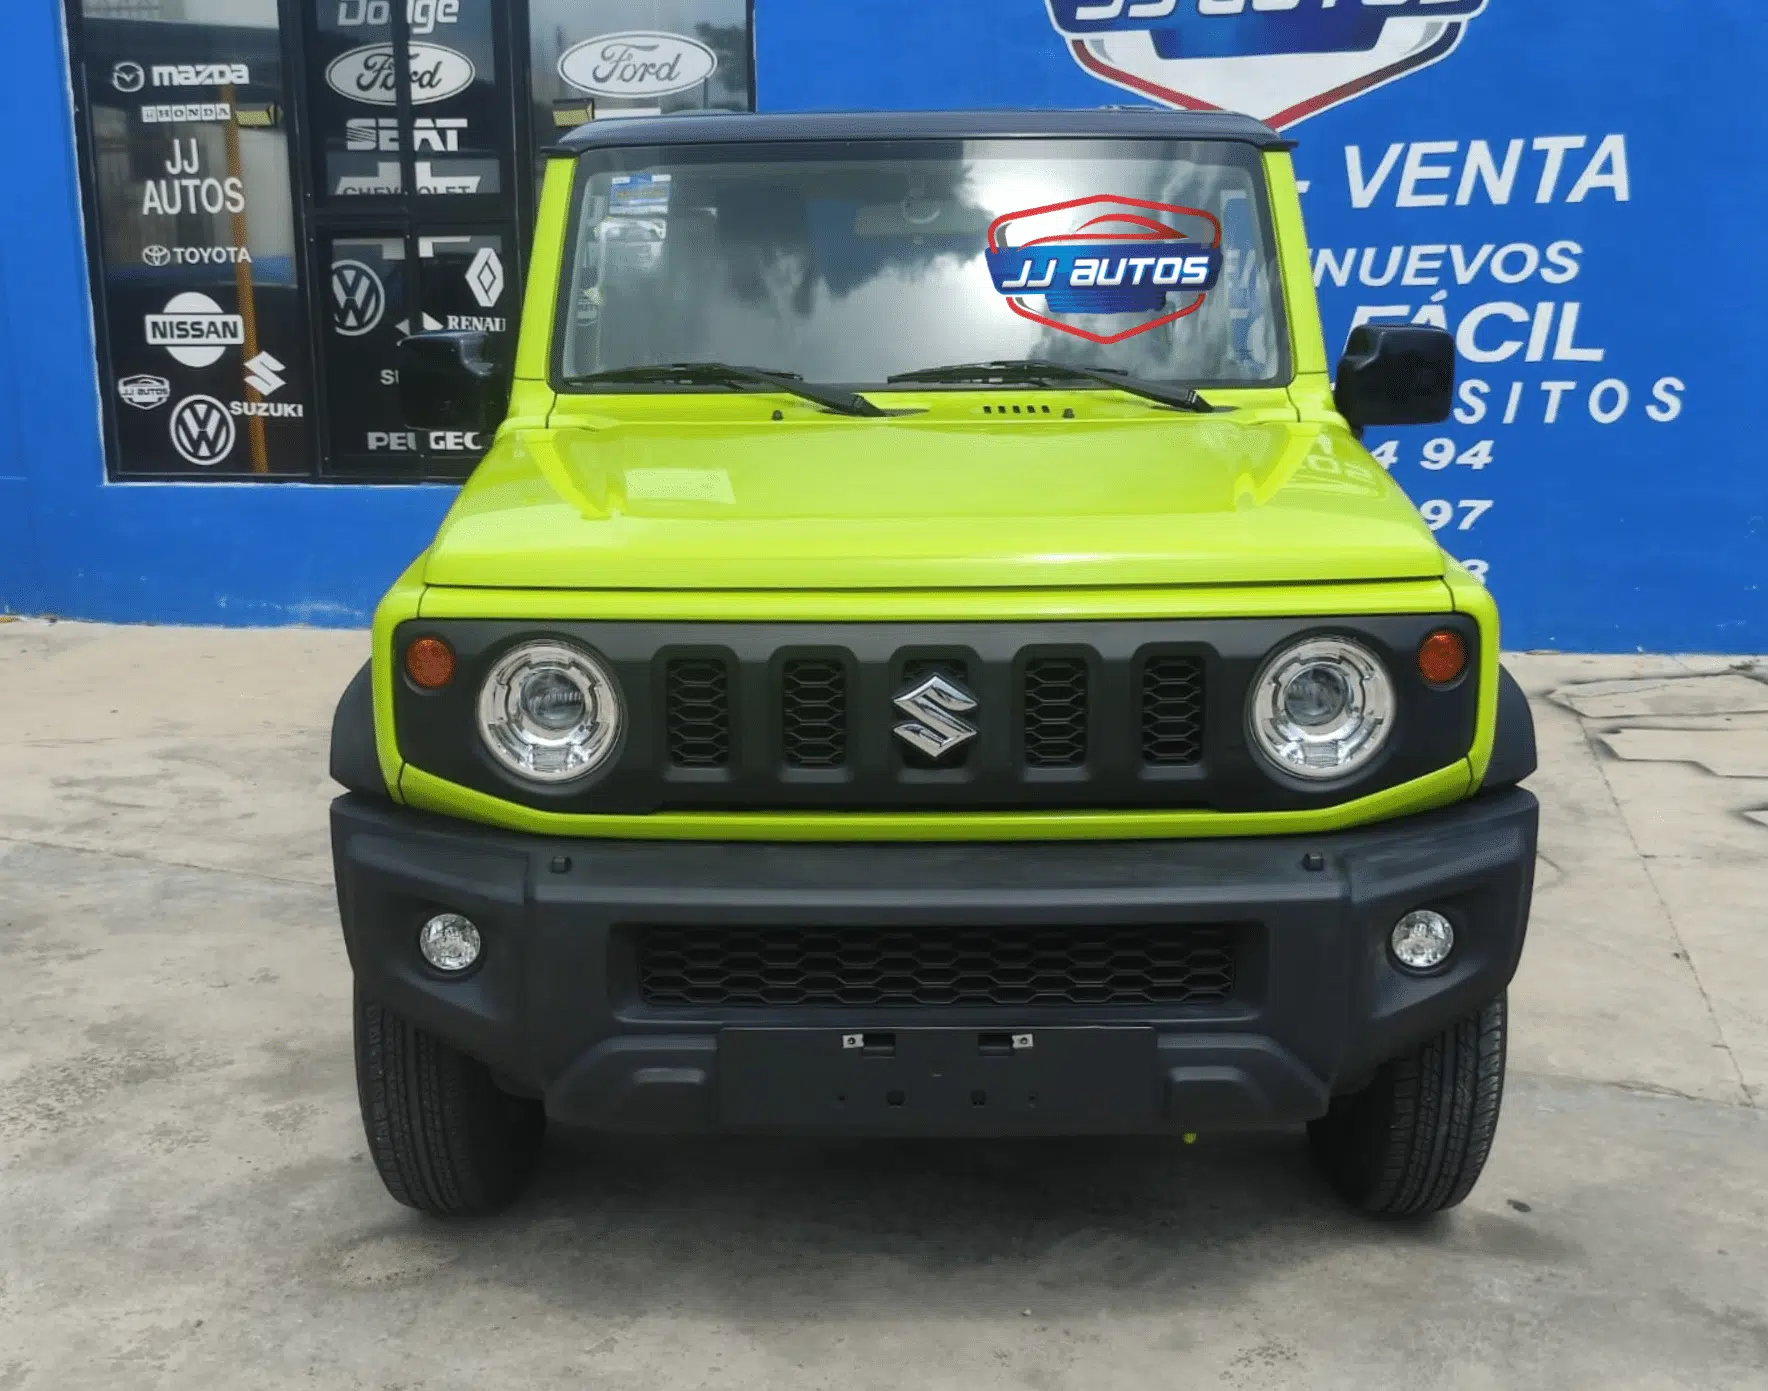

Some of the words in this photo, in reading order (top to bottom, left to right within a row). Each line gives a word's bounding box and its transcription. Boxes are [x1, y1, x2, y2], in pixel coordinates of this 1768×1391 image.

[592, 43, 682, 83] Ford
[346, 117, 468, 152] SEAT
[165, 138, 200, 175] JJ
[1344, 133, 1631, 209] VENTA
[142, 177, 246, 216] AUTOS
[173, 246, 253, 264] TOYOTA
[1308, 239, 1584, 288] NUEVOS
[151, 321, 239, 339] NISSAN
[446, 315, 506, 332] RENAU
[229, 401, 304, 418] SUZUKI
[1452, 376, 1686, 425] SITOS
[1419, 437, 1495, 471] 94
[1420, 498, 1495, 531] 97
